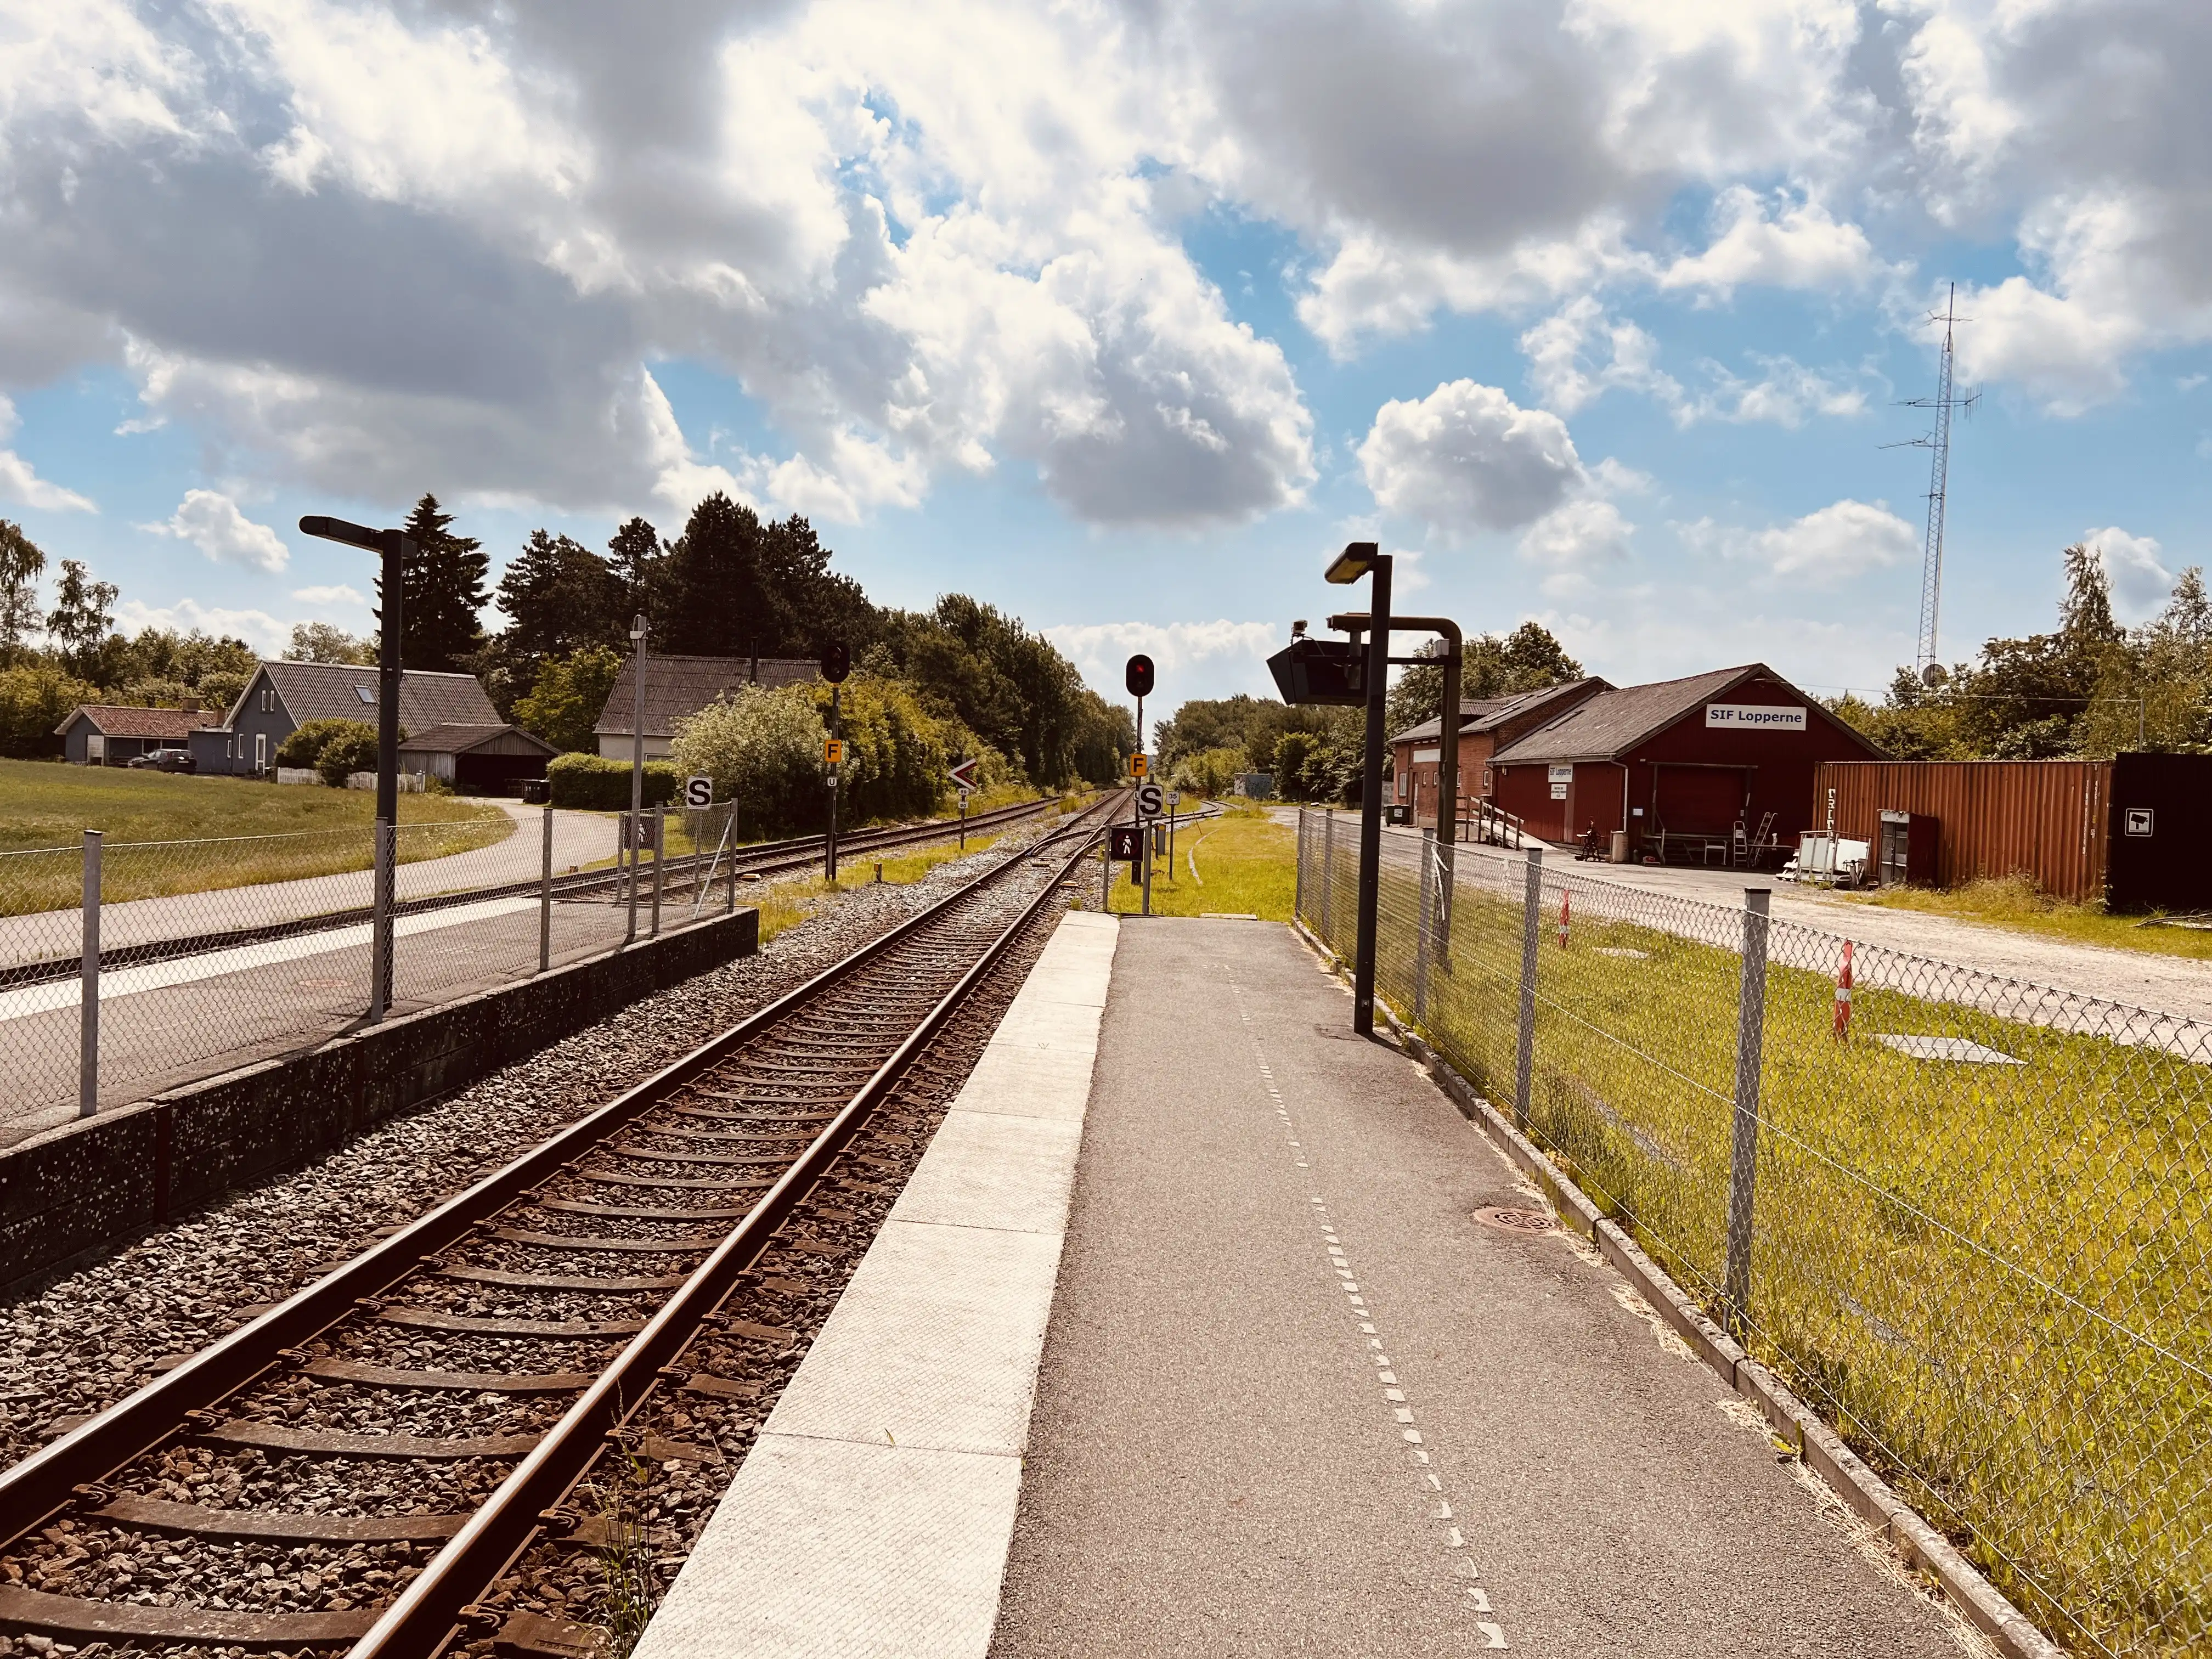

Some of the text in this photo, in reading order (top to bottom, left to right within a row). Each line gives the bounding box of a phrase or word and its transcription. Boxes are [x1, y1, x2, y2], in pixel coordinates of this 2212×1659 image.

[1711, 709, 1802, 723] SIF Lopperne
[828, 743, 838, 758] F
[1133, 758, 1144, 772] F
[688, 780, 710, 806] S
[1139, 787, 1161, 815] S
